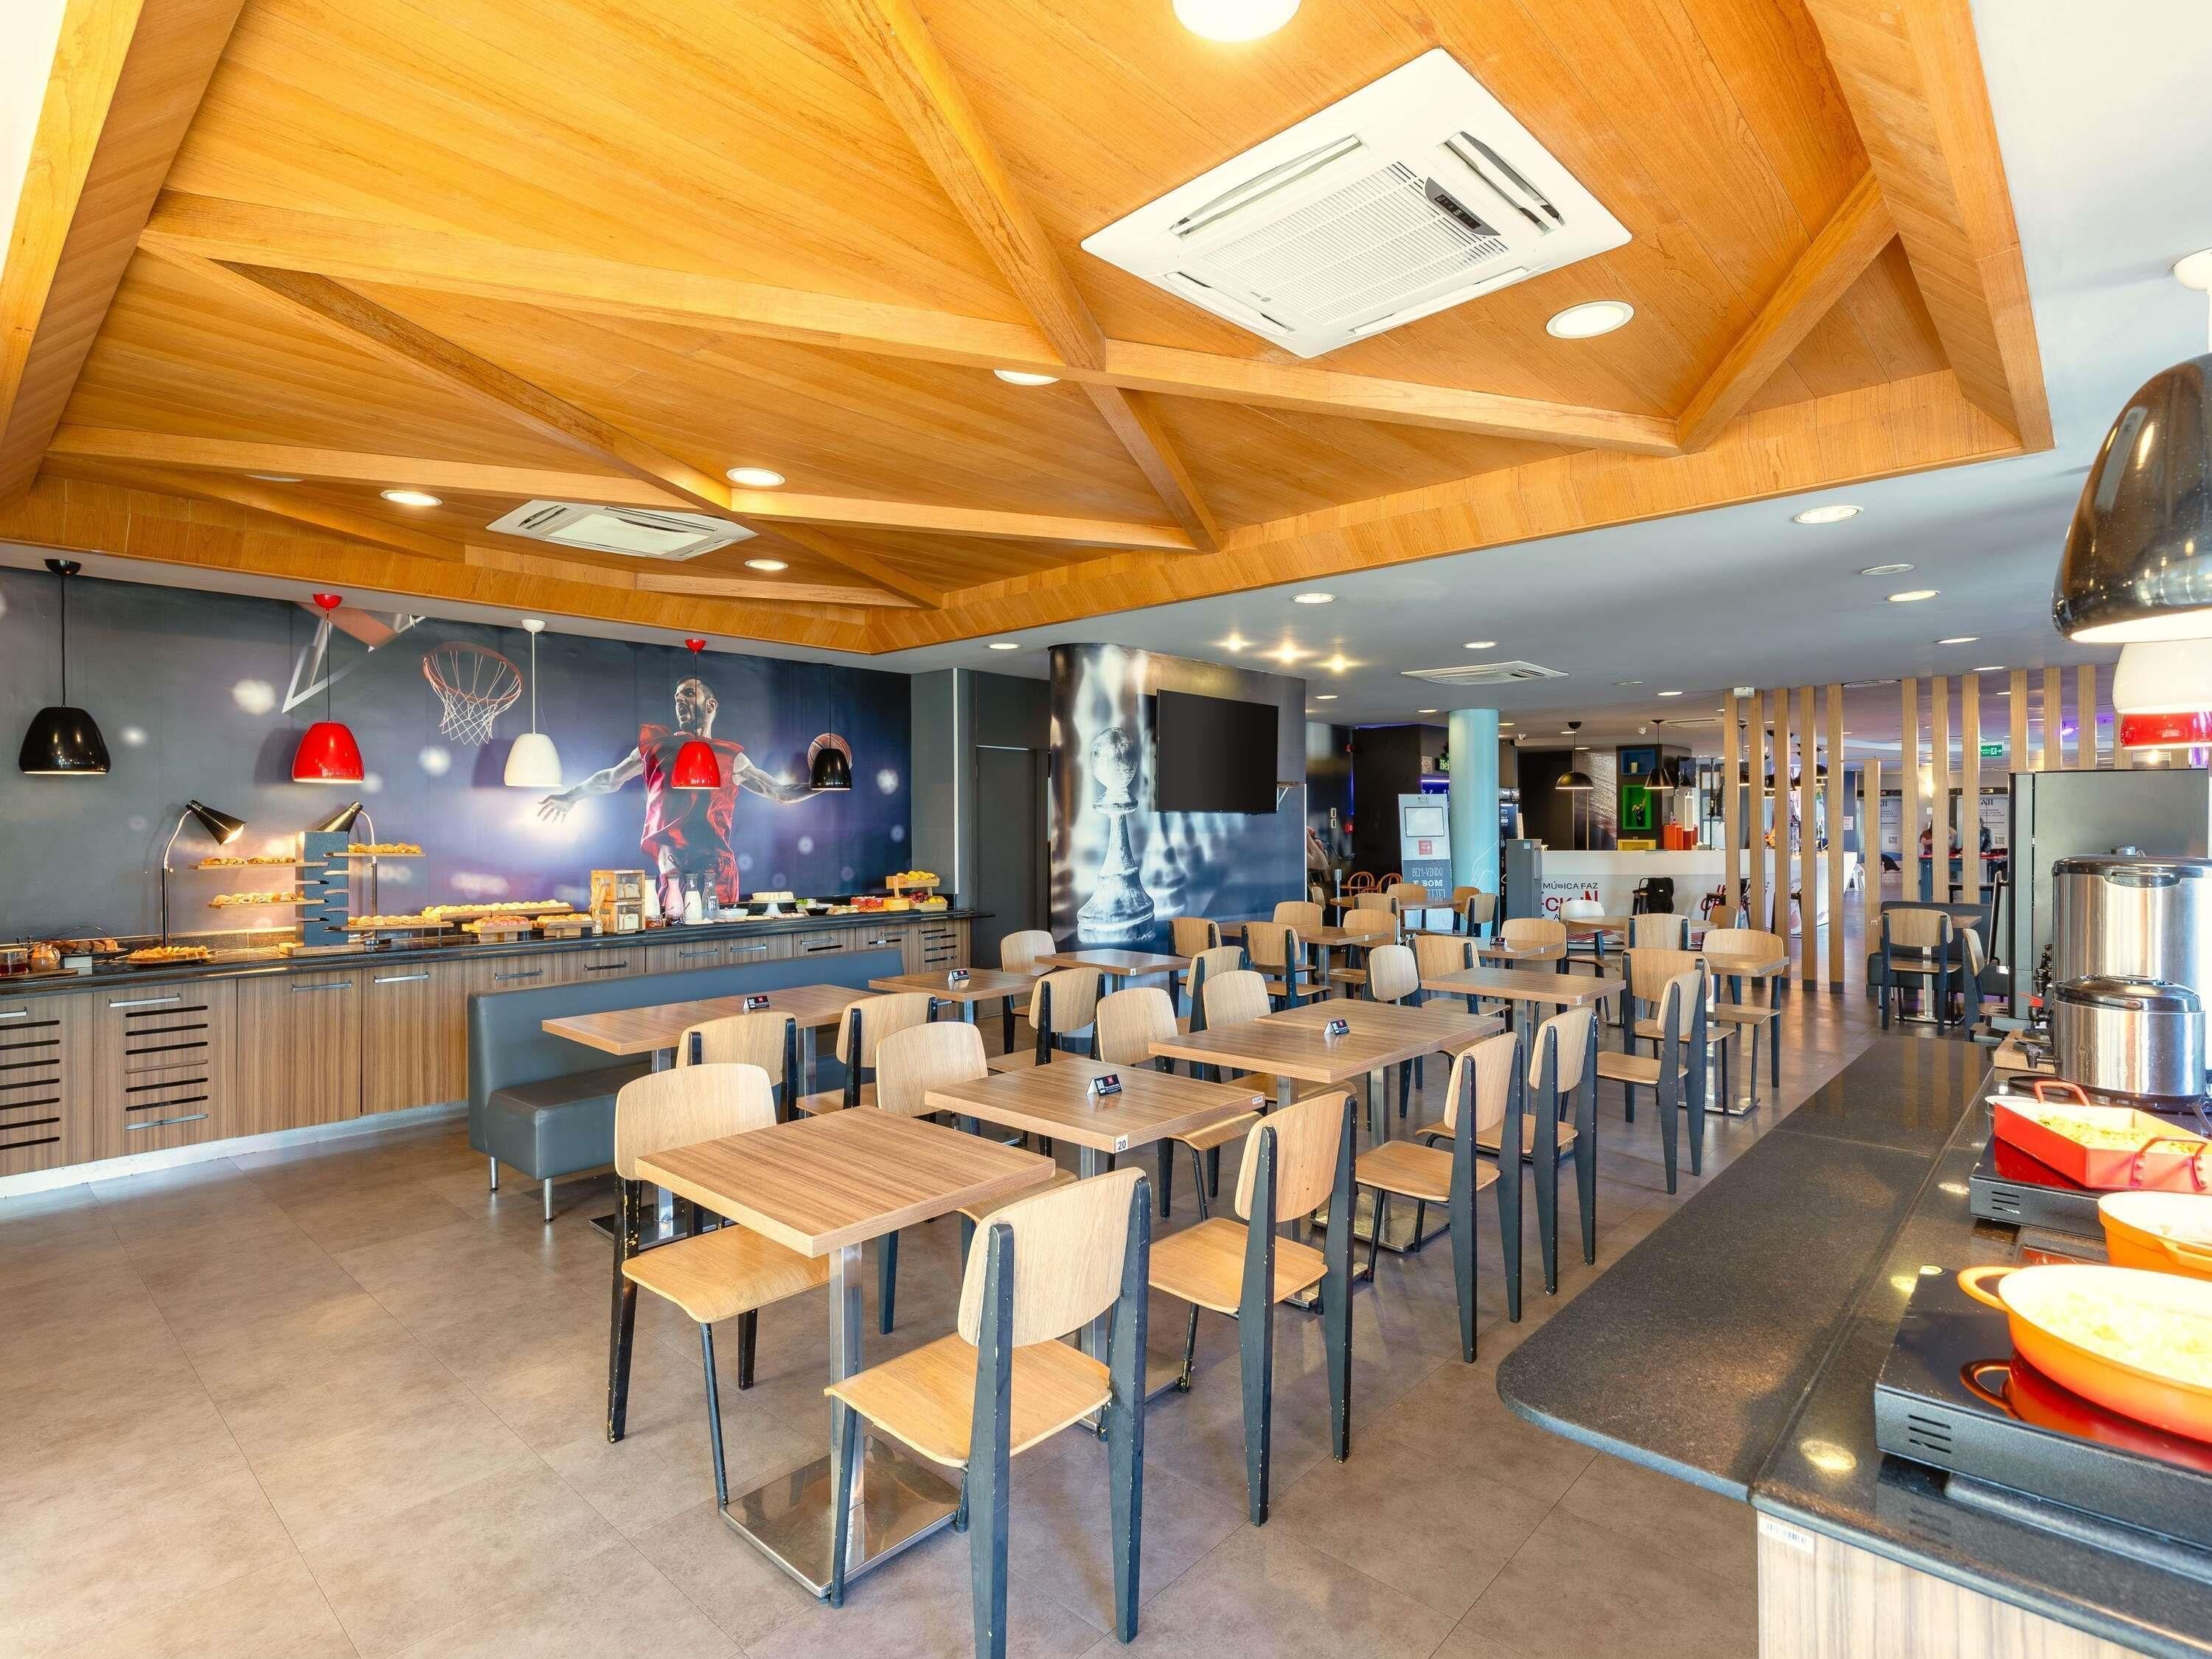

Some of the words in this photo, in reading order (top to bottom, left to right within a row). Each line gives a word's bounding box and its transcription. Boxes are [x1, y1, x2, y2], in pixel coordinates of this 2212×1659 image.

[1412, 867, 1443, 877] BEM-VINDO
[1543, 881, 1579, 889] MÚSICA
[1118, 1140, 1126, 1150] 20
